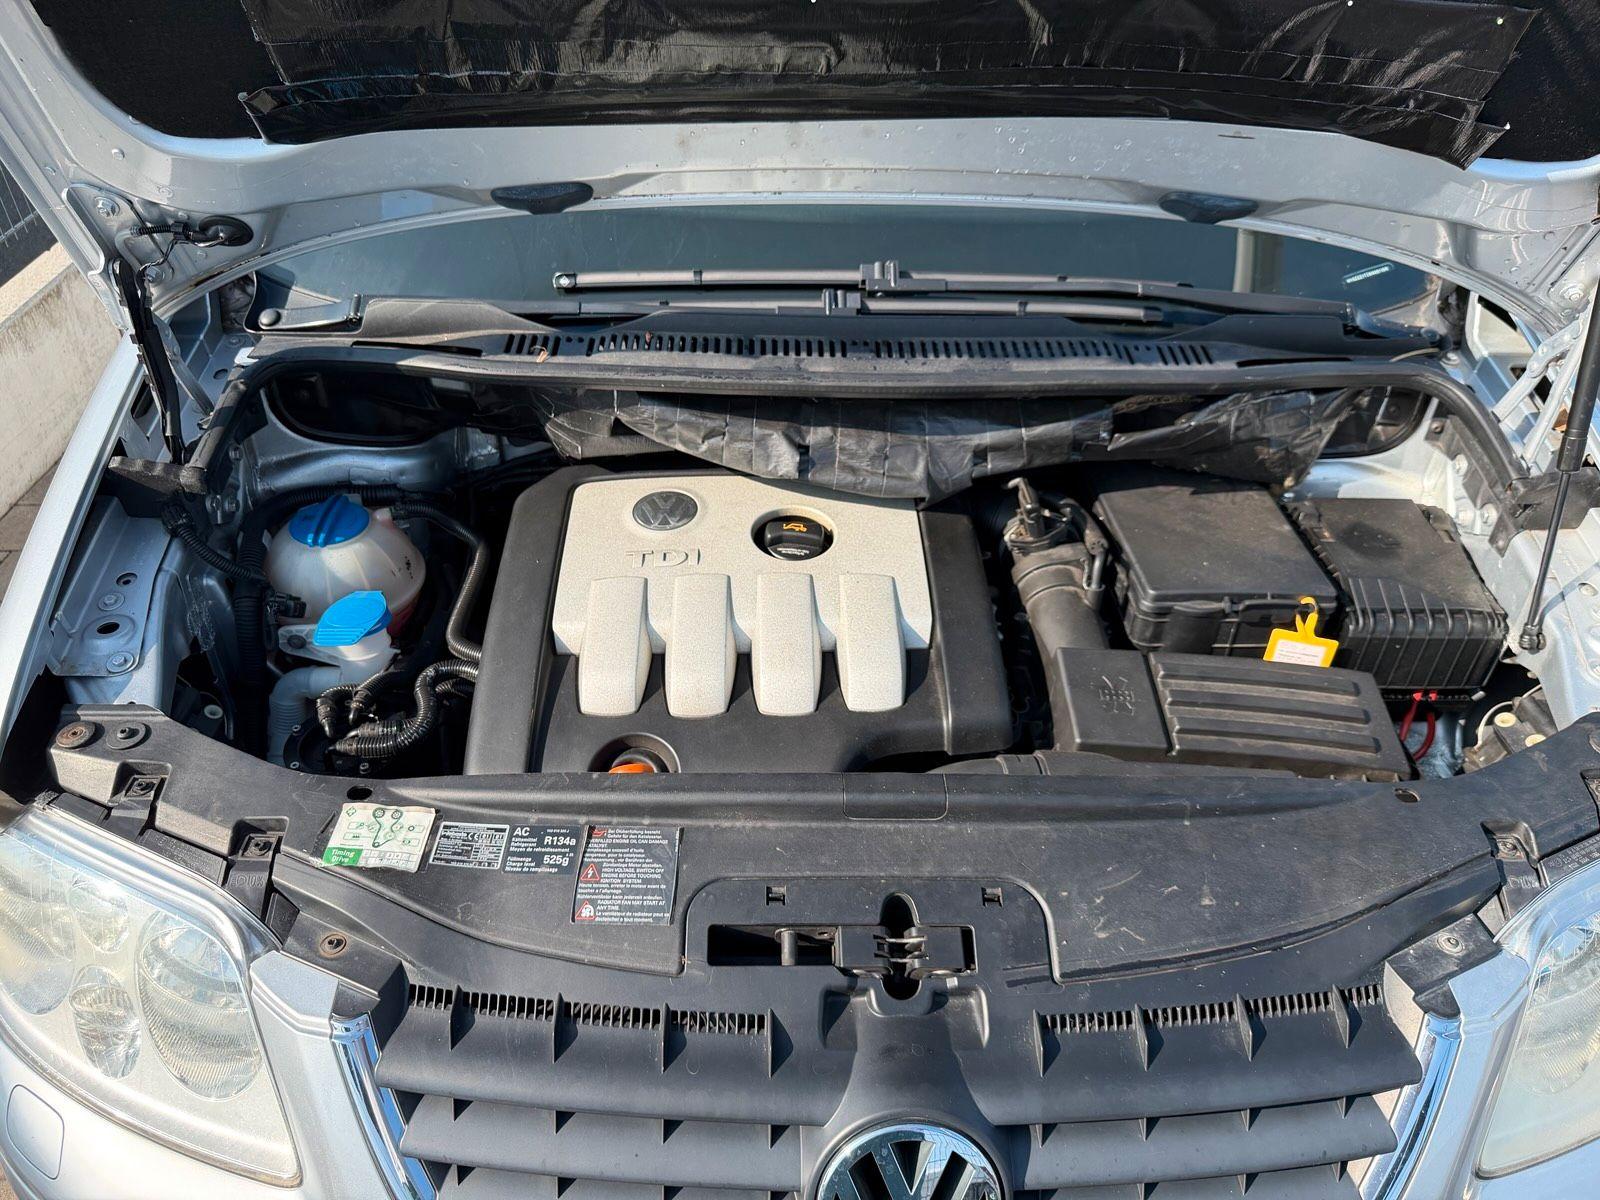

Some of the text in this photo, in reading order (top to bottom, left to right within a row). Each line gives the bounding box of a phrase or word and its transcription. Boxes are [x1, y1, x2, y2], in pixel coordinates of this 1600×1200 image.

[626, 548, 701, 568] TDI
[513, 827, 530, 836] AC
[544, 836, 576, 846] R134a
[332, 849, 355, 857] Timing
[543, 855, 570, 866] 525g
